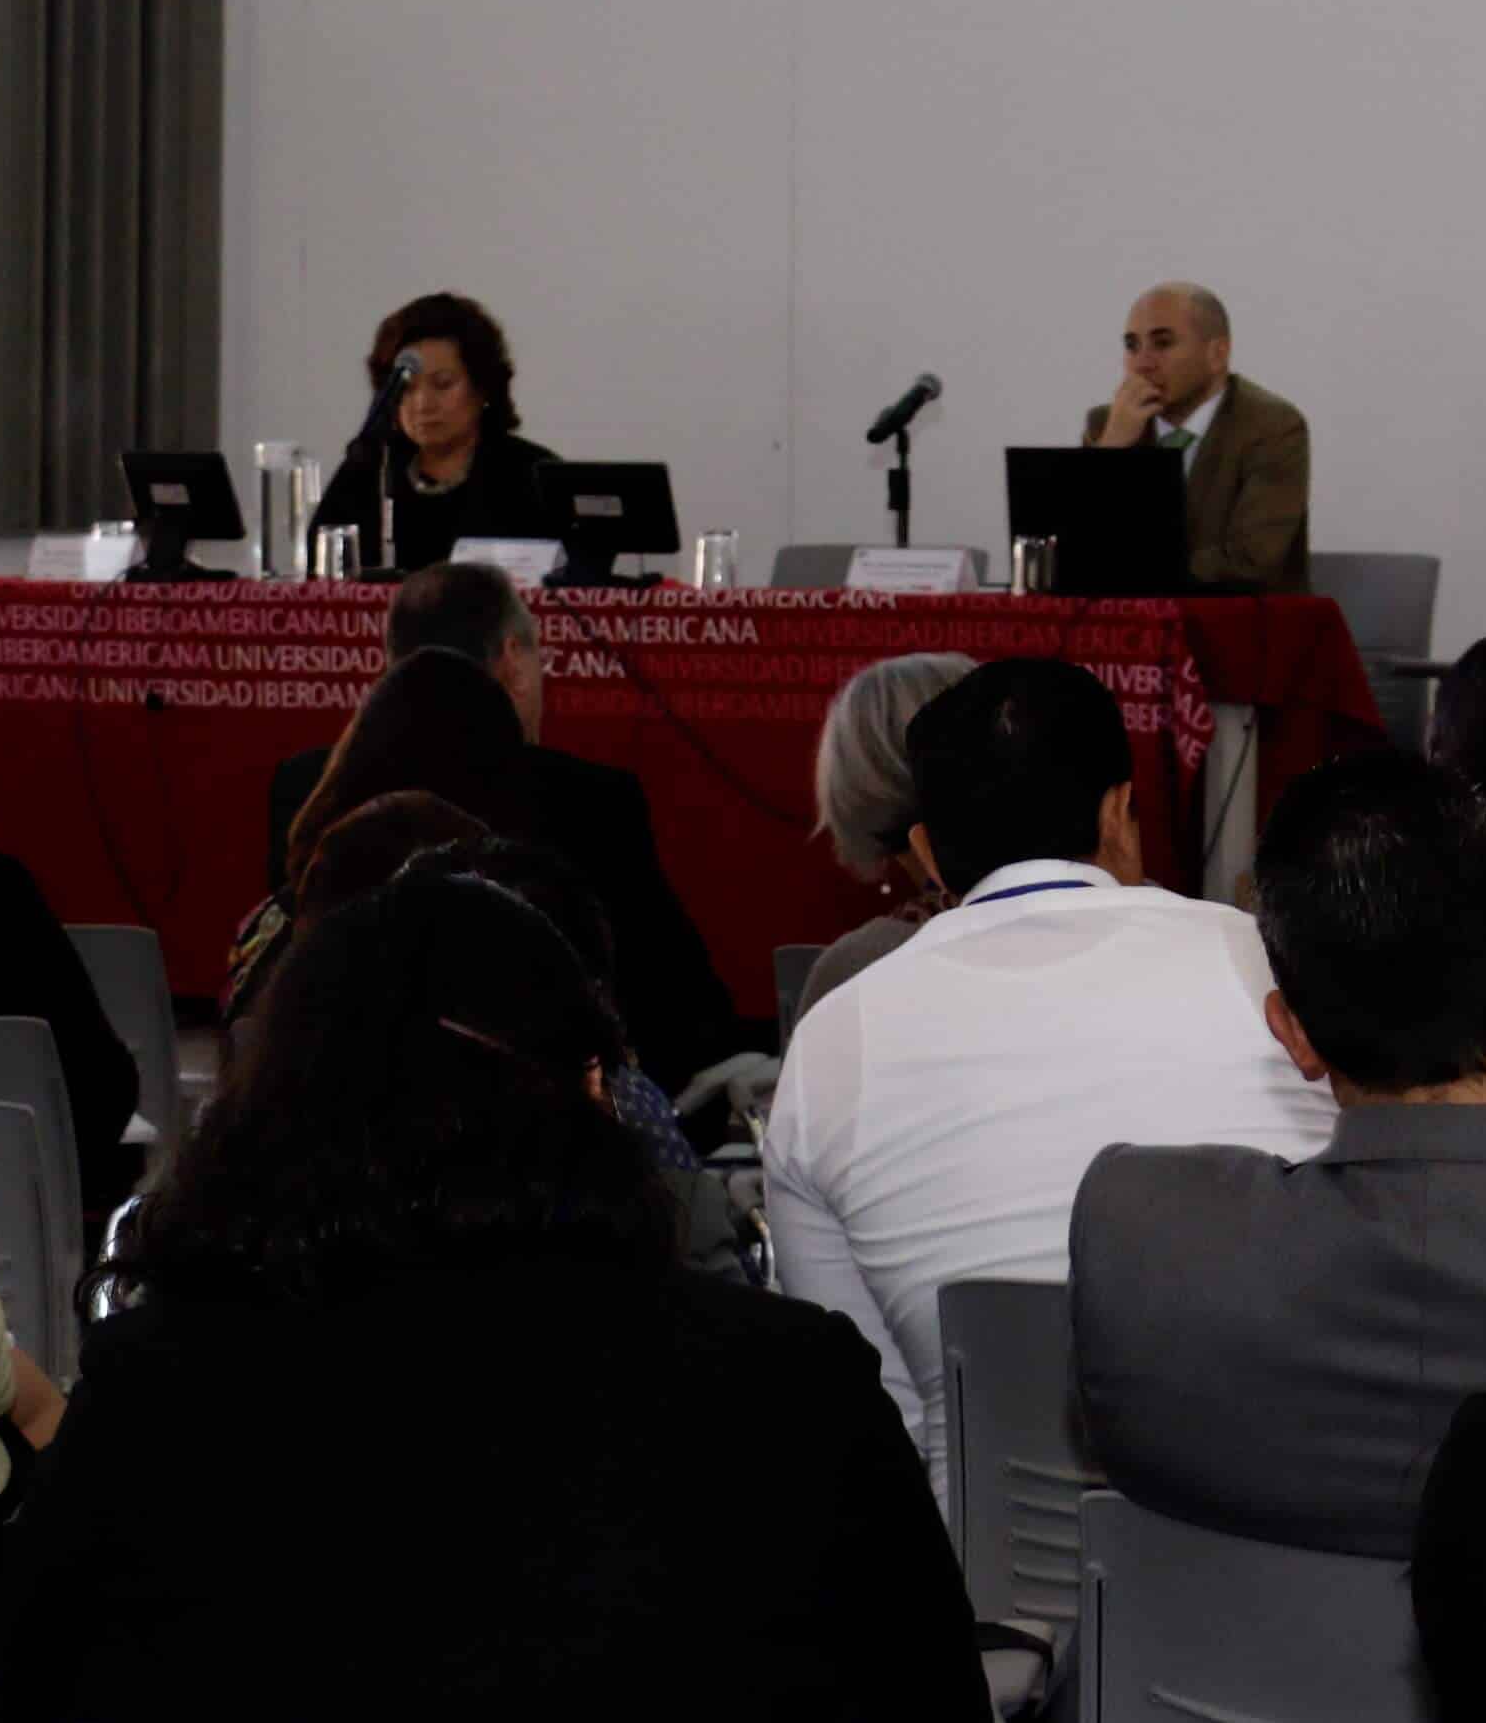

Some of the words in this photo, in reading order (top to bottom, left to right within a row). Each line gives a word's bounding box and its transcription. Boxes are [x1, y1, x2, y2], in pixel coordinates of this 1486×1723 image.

[115, 606, 339, 637] IBEROAMERICANA
[537, 614, 760, 645] BEROAMERICANA
[215, 643, 385, 675] UNIVERSIDAD
